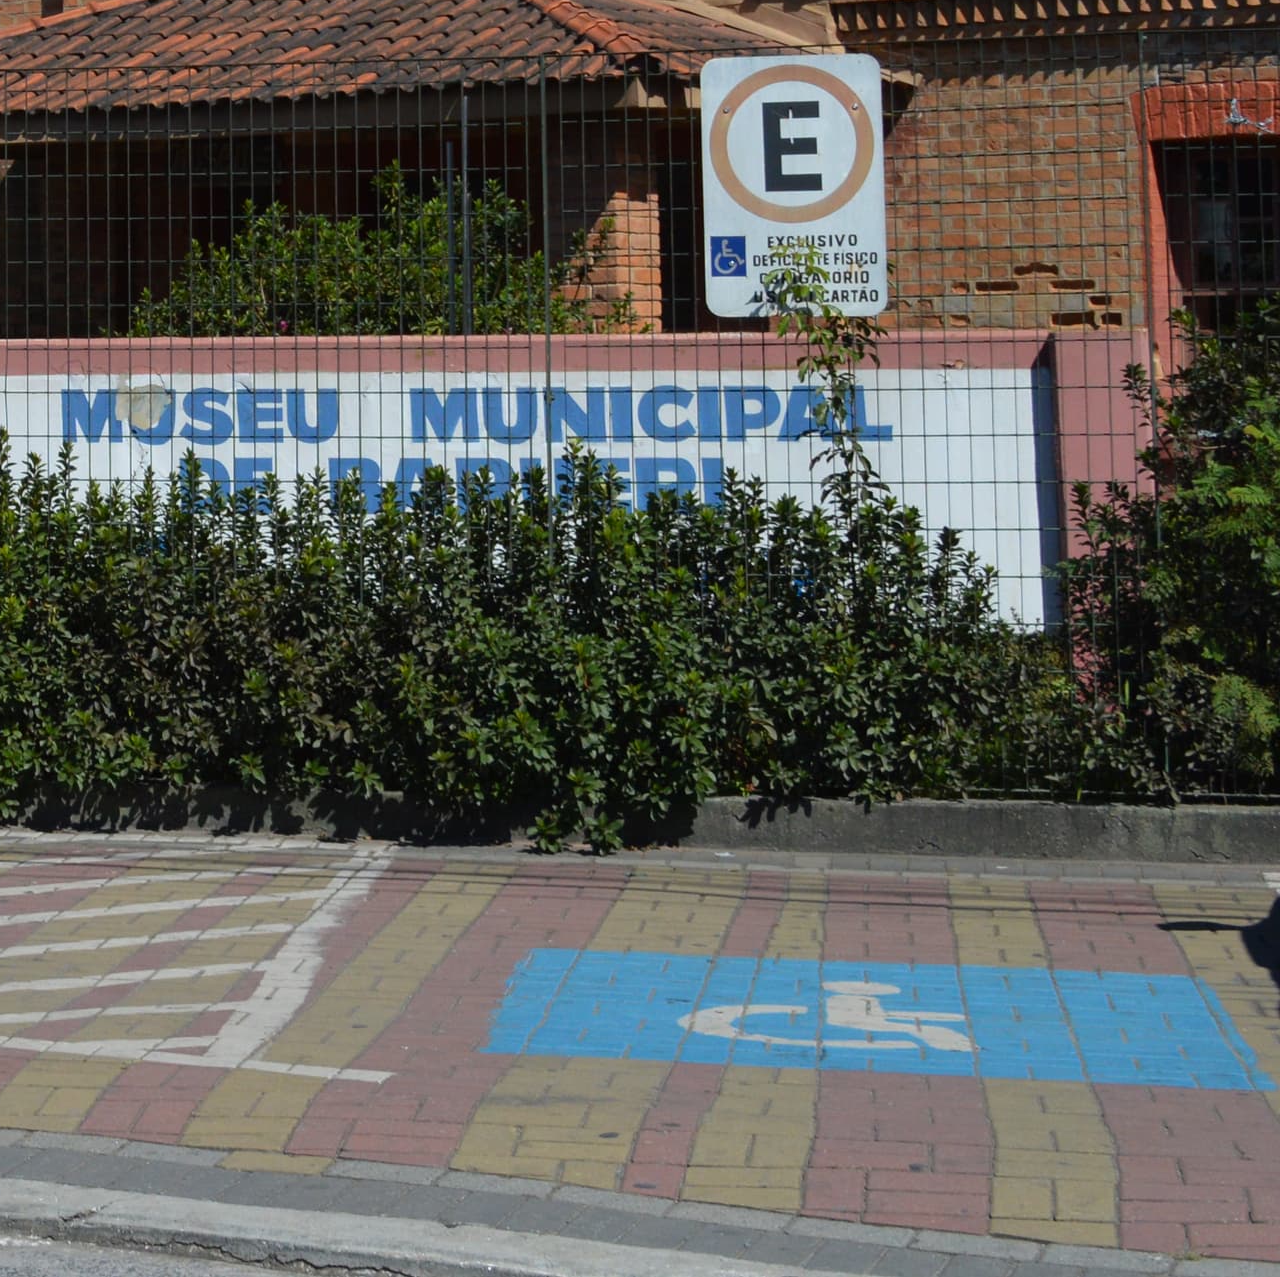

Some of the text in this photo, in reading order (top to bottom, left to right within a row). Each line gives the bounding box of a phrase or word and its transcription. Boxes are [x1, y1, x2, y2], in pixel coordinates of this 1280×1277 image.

[762, 101, 822, 192] E
[768, 234, 857, 248] EXCLUSIVO
[753, 253, 830, 267] DEFICITE
[759, 269, 870, 285] OIGAÓRIO
[754, 290, 787, 303] US
[822, 286, 879, 303] CARTÃO
[60, 384, 894, 446] MUSEU MUNICIPAL
[179, 456, 273, 516] DE
